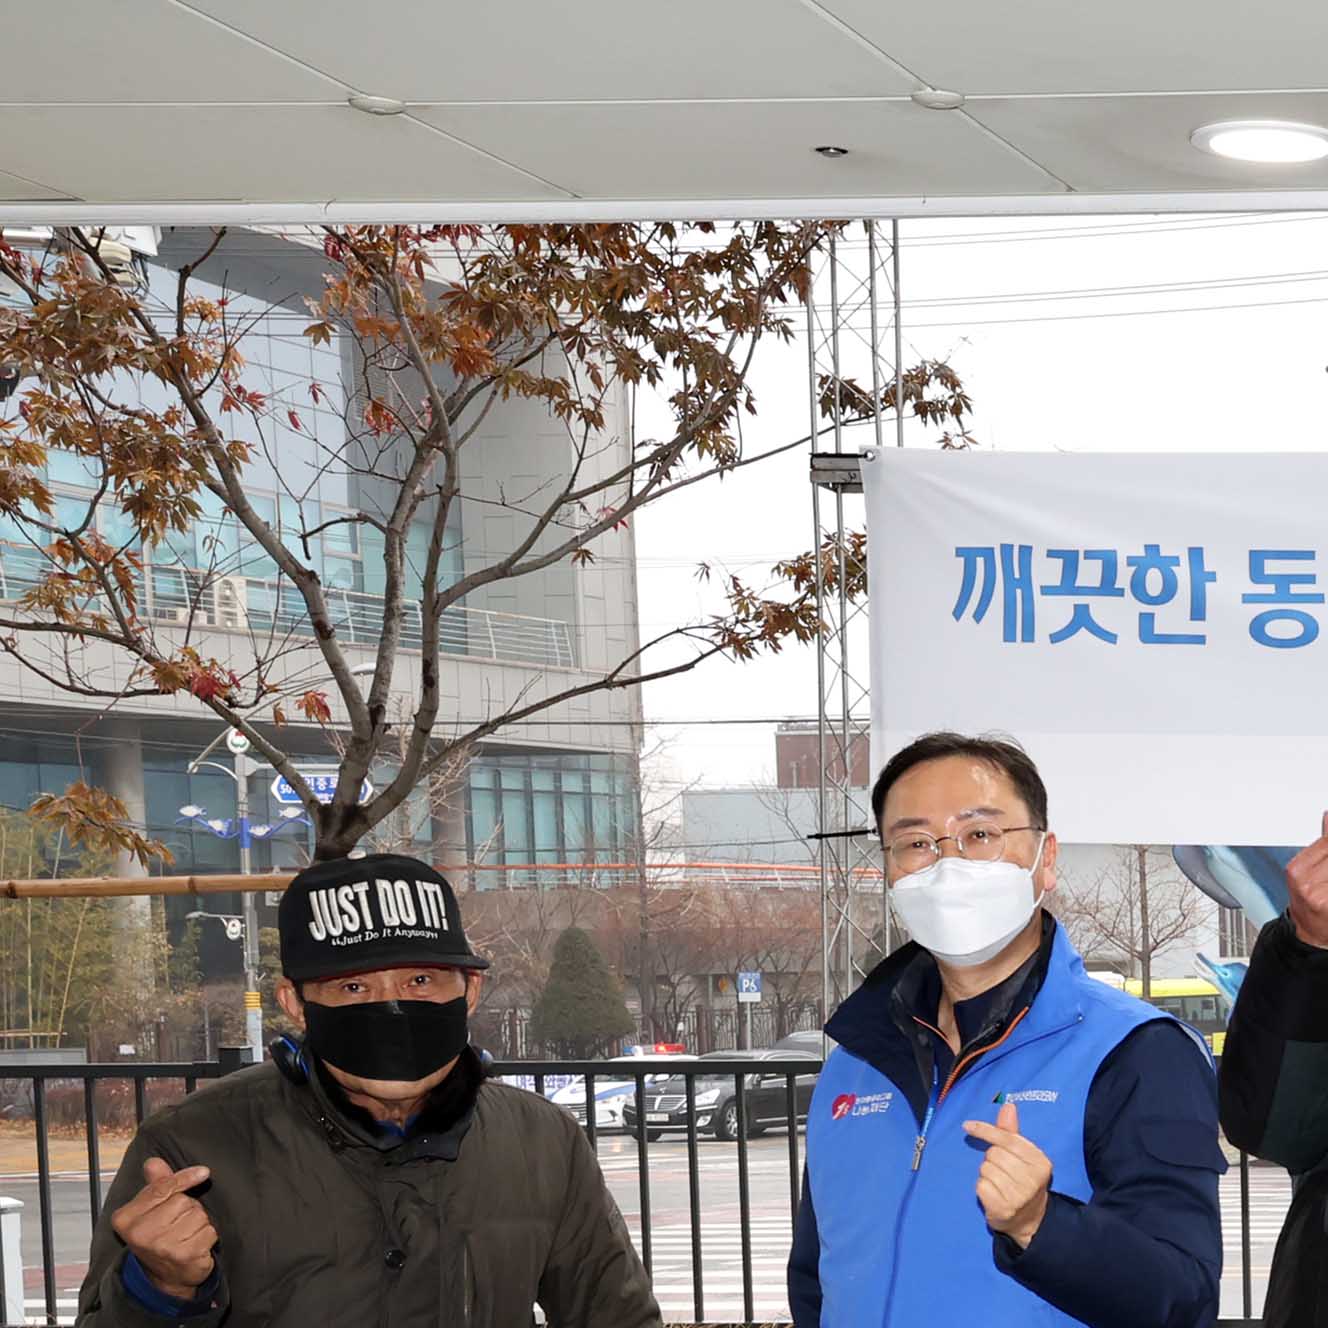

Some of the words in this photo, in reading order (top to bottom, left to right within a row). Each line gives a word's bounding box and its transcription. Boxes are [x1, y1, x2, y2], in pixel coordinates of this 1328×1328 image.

[953, 544, 1217, 646] 깨끗한
[308, 881, 374, 942] JUST
[375, 878, 417, 927] DO
[415, 879, 449, 931] IT!
[364, 930, 379, 941] Do
[383, 928, 392, 938] It
